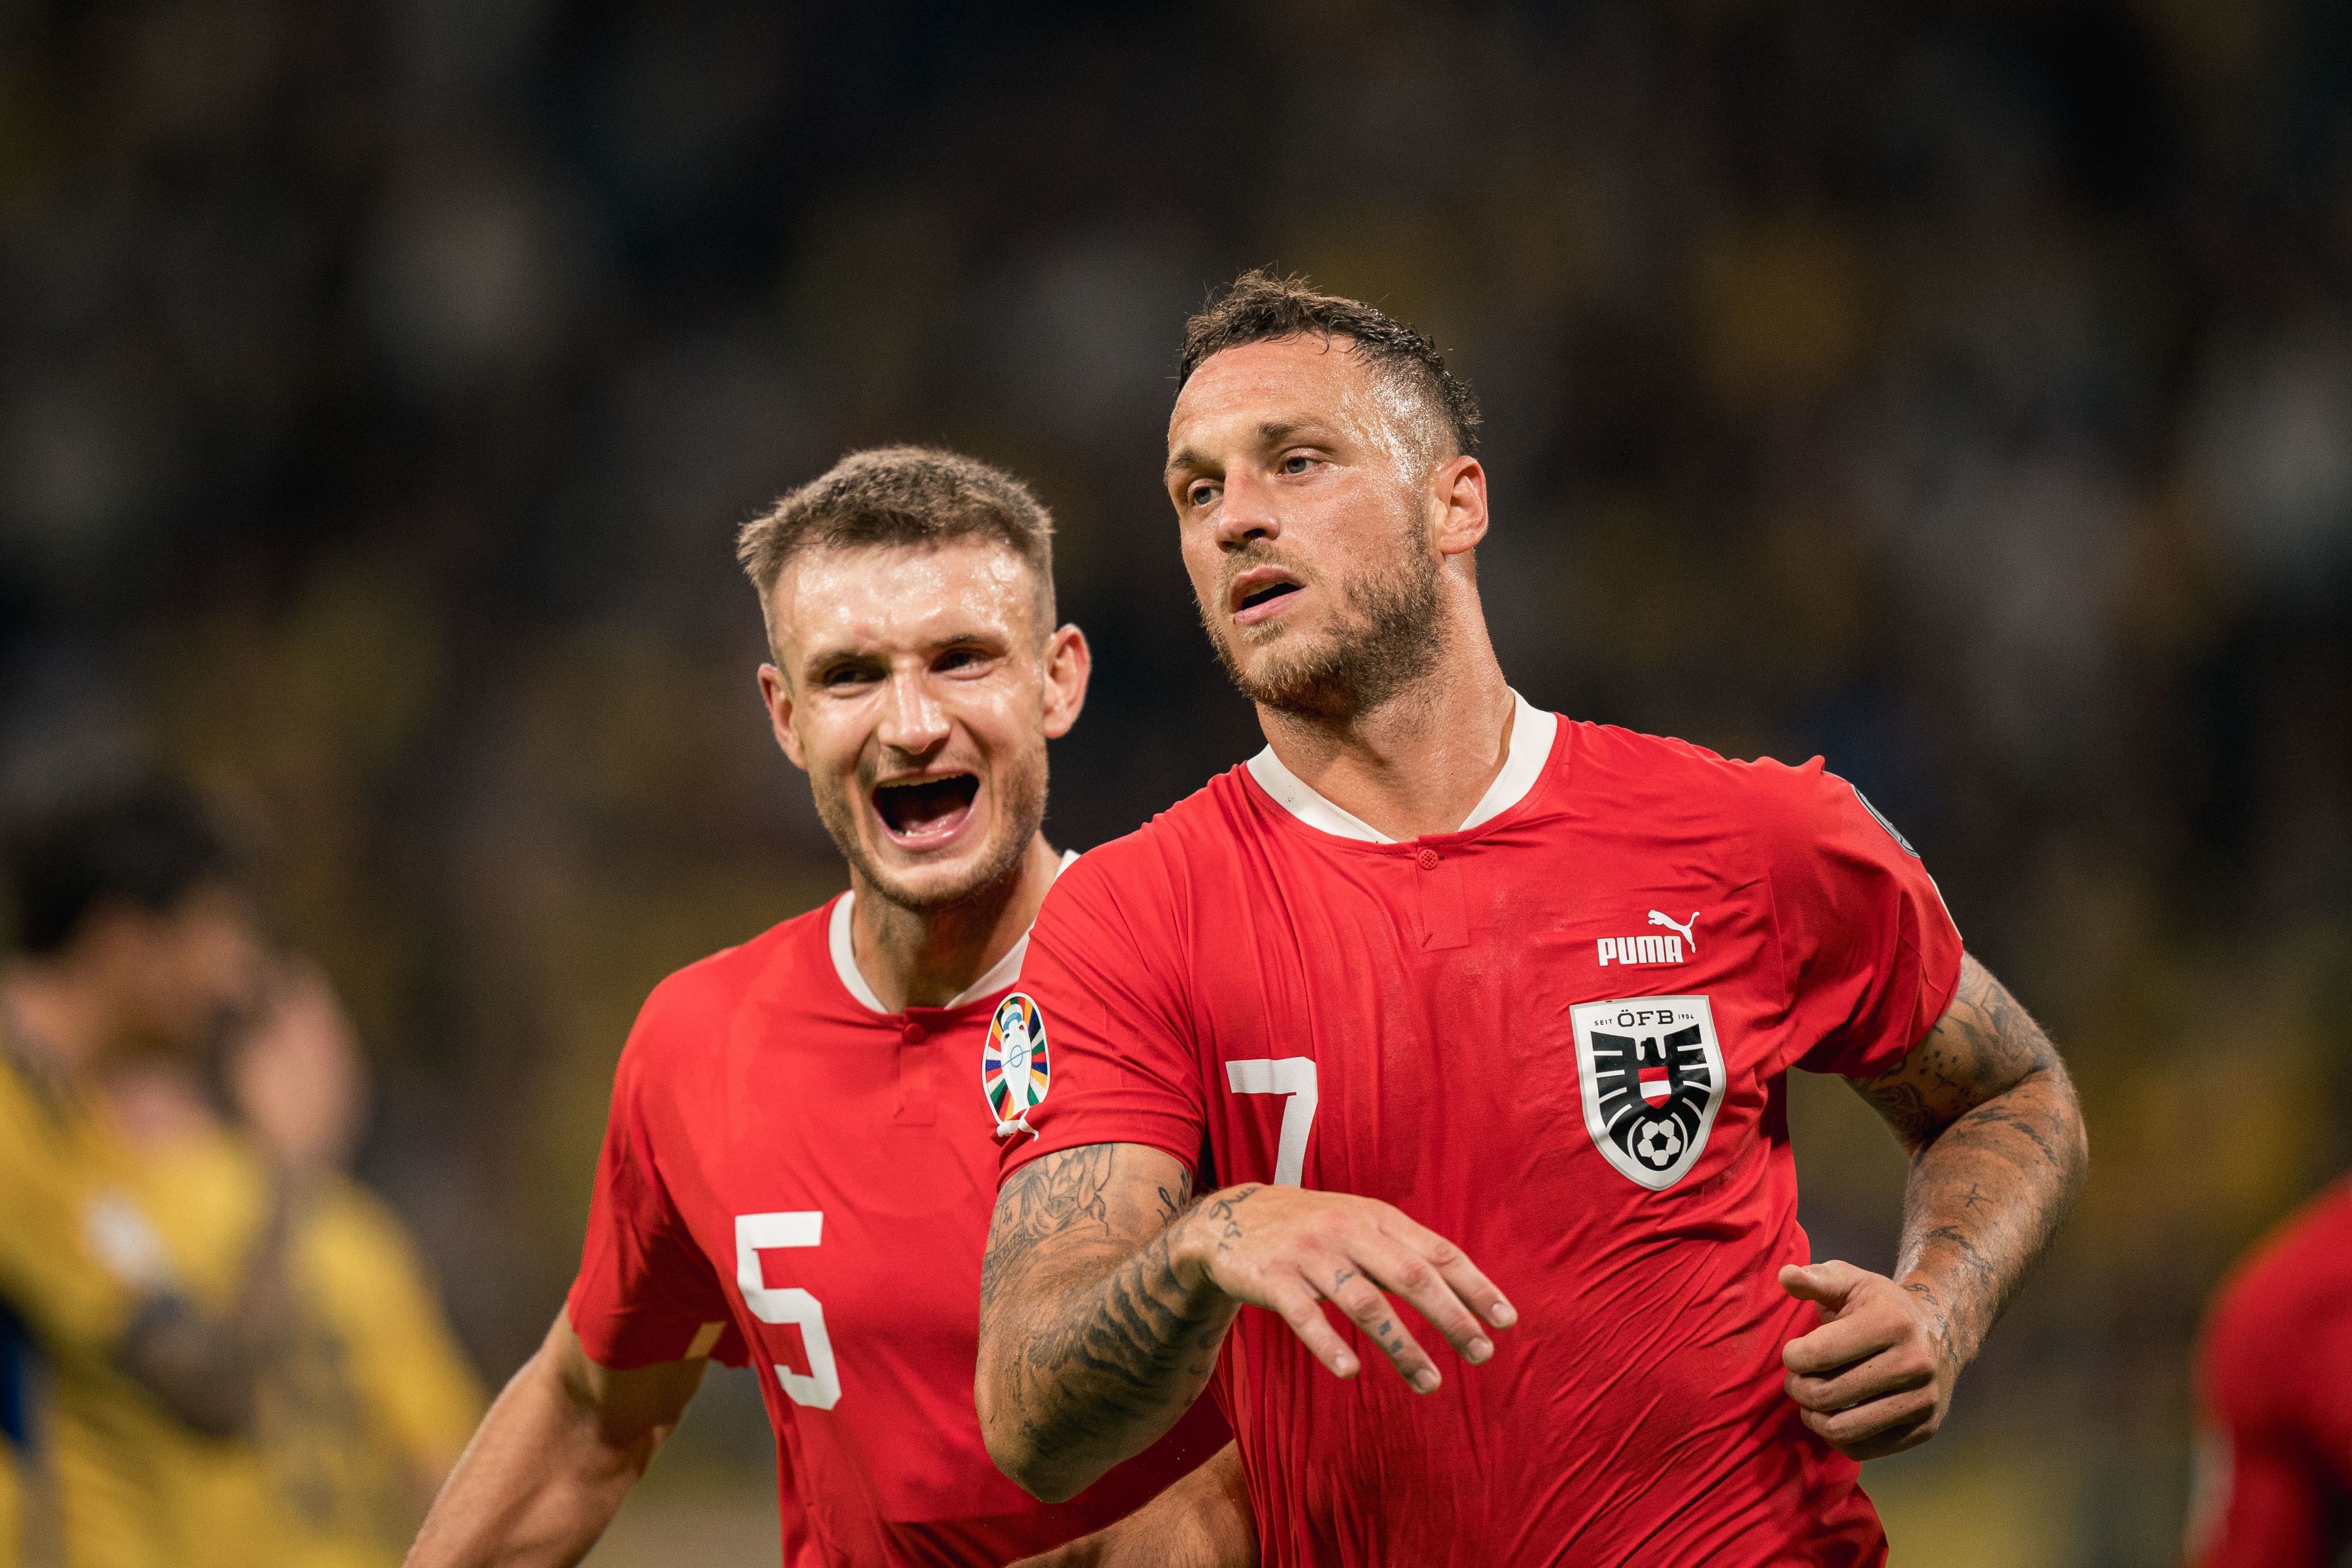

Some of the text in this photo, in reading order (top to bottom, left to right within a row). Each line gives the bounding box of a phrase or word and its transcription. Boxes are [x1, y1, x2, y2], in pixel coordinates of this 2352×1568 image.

[1597, 935, 1683, 966] PUMA
[1617, 1009, 1674, 1027] ÖFB
[1225, 1057, 1318, 1188] 7
[735, 1211, 841, 1410] 5
